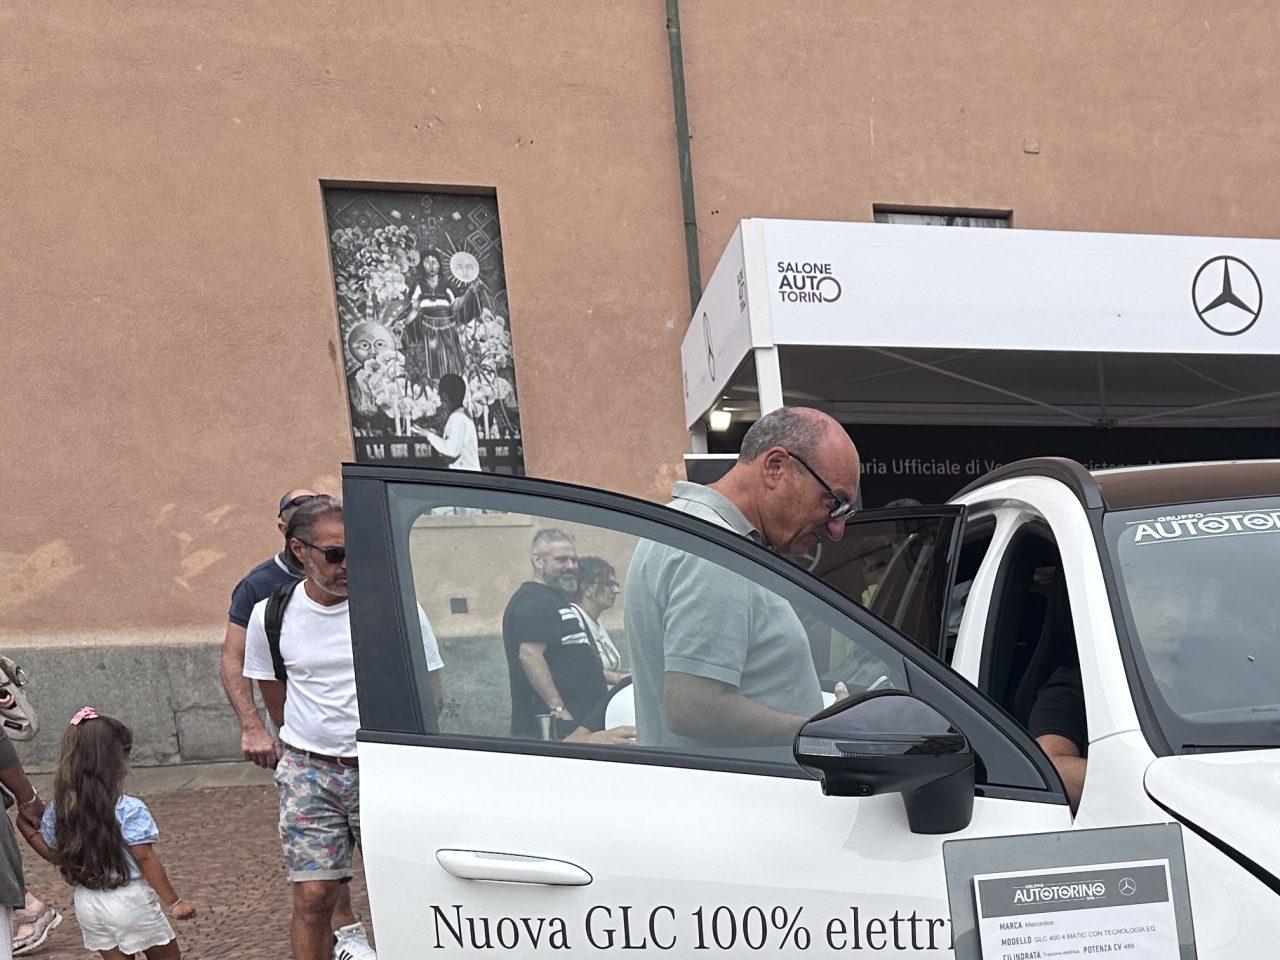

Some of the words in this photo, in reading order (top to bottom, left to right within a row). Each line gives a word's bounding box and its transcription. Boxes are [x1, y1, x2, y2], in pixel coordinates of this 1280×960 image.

[777, 261, 832, 274] SALONE
[779, 275, 842, 302] AUTO
[893, 459, 960, 475] Ufficiale
[966, 459, 979, 475] di
[1157, 512, 1205, 523] GRUPPO
[1012, 881, 1105, 903] AUTOTORINO
[430, 904, 571, 950] Nuova
[585, 904, 677, 950] GLC
[692, 905, 811, 951] 100%
[999, 921, 1022, 930] MARCA
[1025, 919, 1053, 927] Mercedes
[1001, 936, 1031, 946] MODELLO
[1104, 925, 1145, 935] TECNOLOGIA
[1083, 944, 1112, 953] POTENZA
